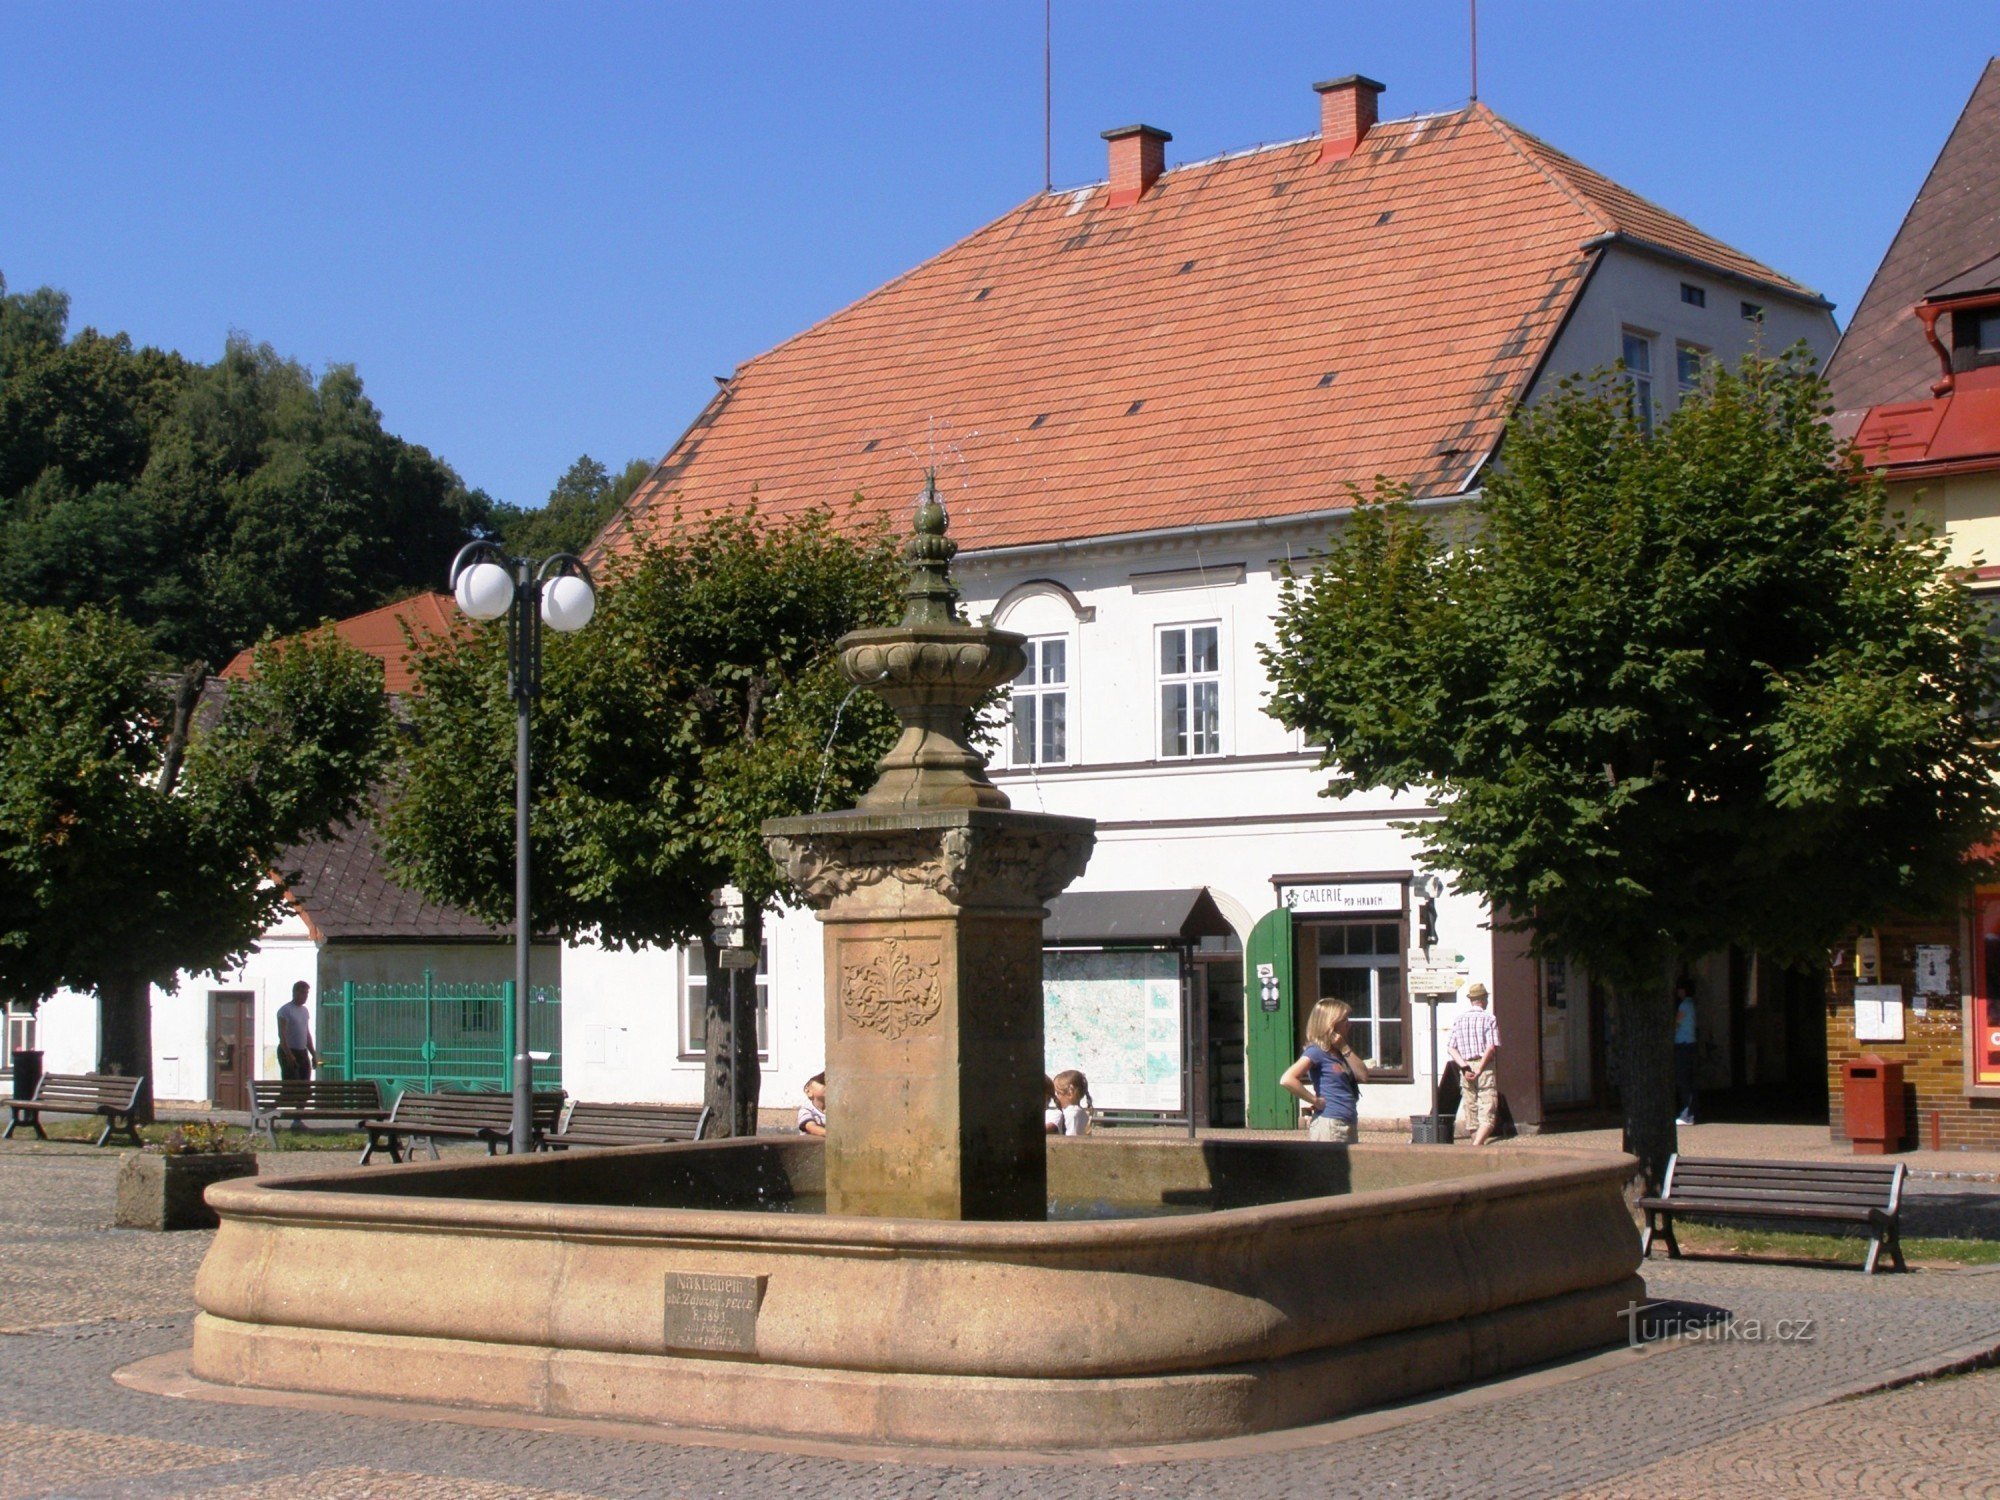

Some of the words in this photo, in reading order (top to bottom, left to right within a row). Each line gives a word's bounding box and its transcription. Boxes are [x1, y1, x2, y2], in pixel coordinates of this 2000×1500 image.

[1303, 888, 1342, 903] GALERIE
[1344, 897, 1355, 906] POD
[1356, 896, 1383, 906] HRADEM
